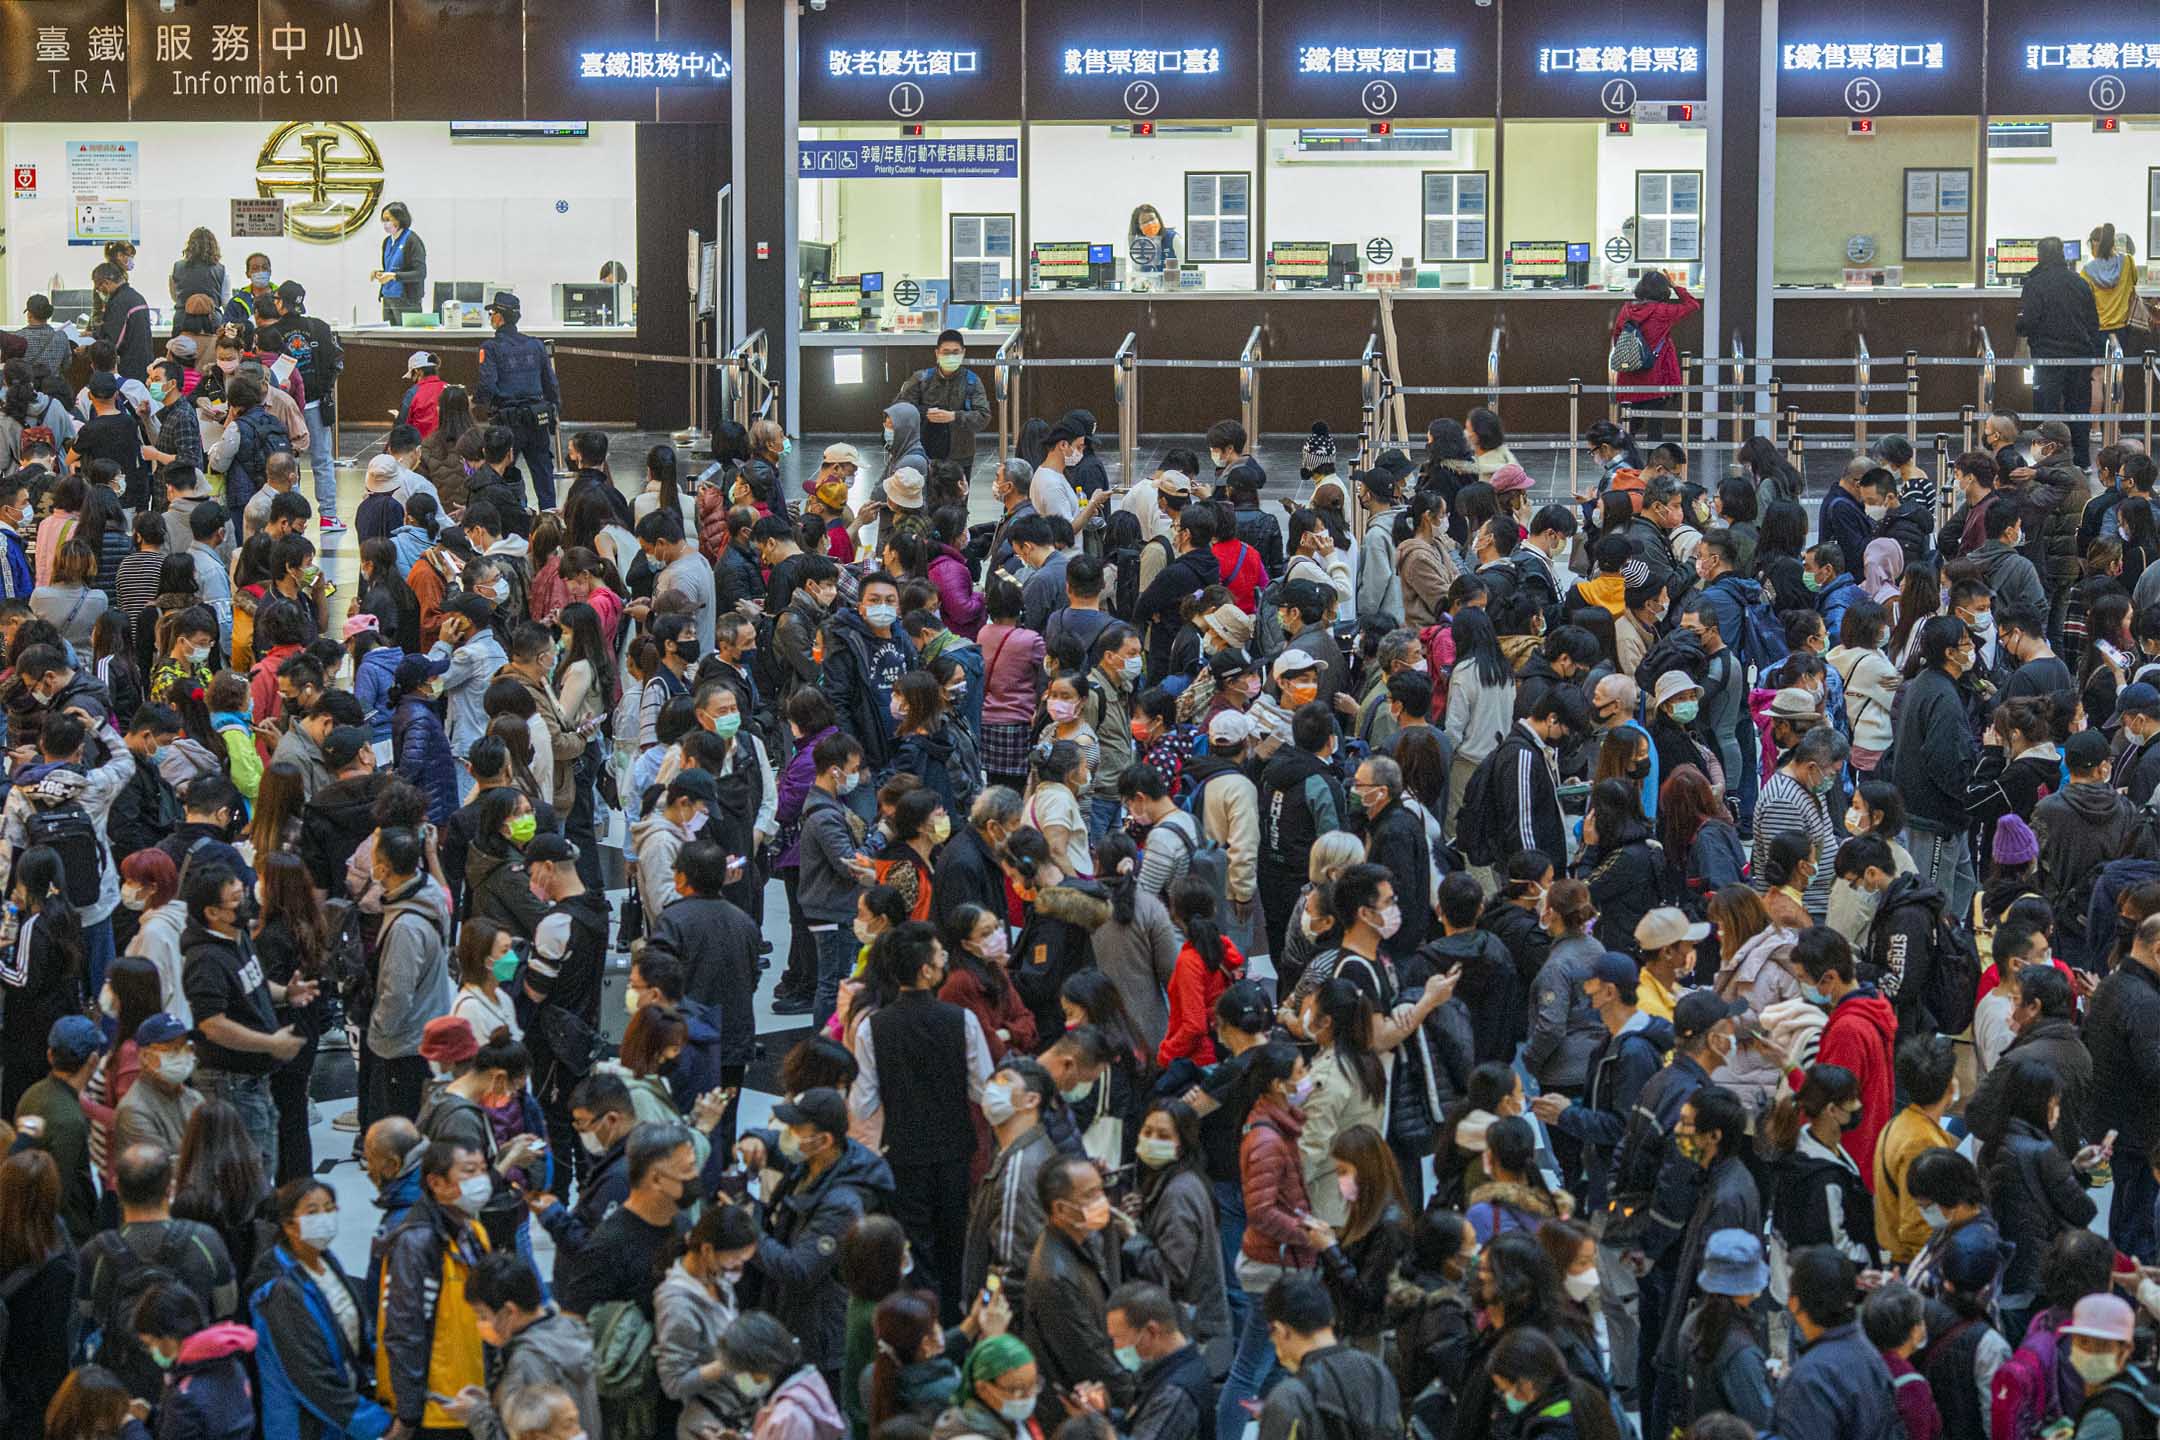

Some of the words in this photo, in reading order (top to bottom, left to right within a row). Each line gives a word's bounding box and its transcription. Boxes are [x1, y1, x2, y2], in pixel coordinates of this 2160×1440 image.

[36, 21, 364, 62] 臺鐵服務中心
[580, 52, 731, 79] 臺鐵服務中心
[829, 49, 977, 76] 敬老優先窗口
[1300, 47, 1457, 73] 鐵售票窗口臺
[47, 69, 116, 95] TRA
[172, 70, 338, 95] Information
[1682, 105, 1691, 120] 7
[874, 165, 894, 175] Priority
[894, 165, 916, 174] Counter
